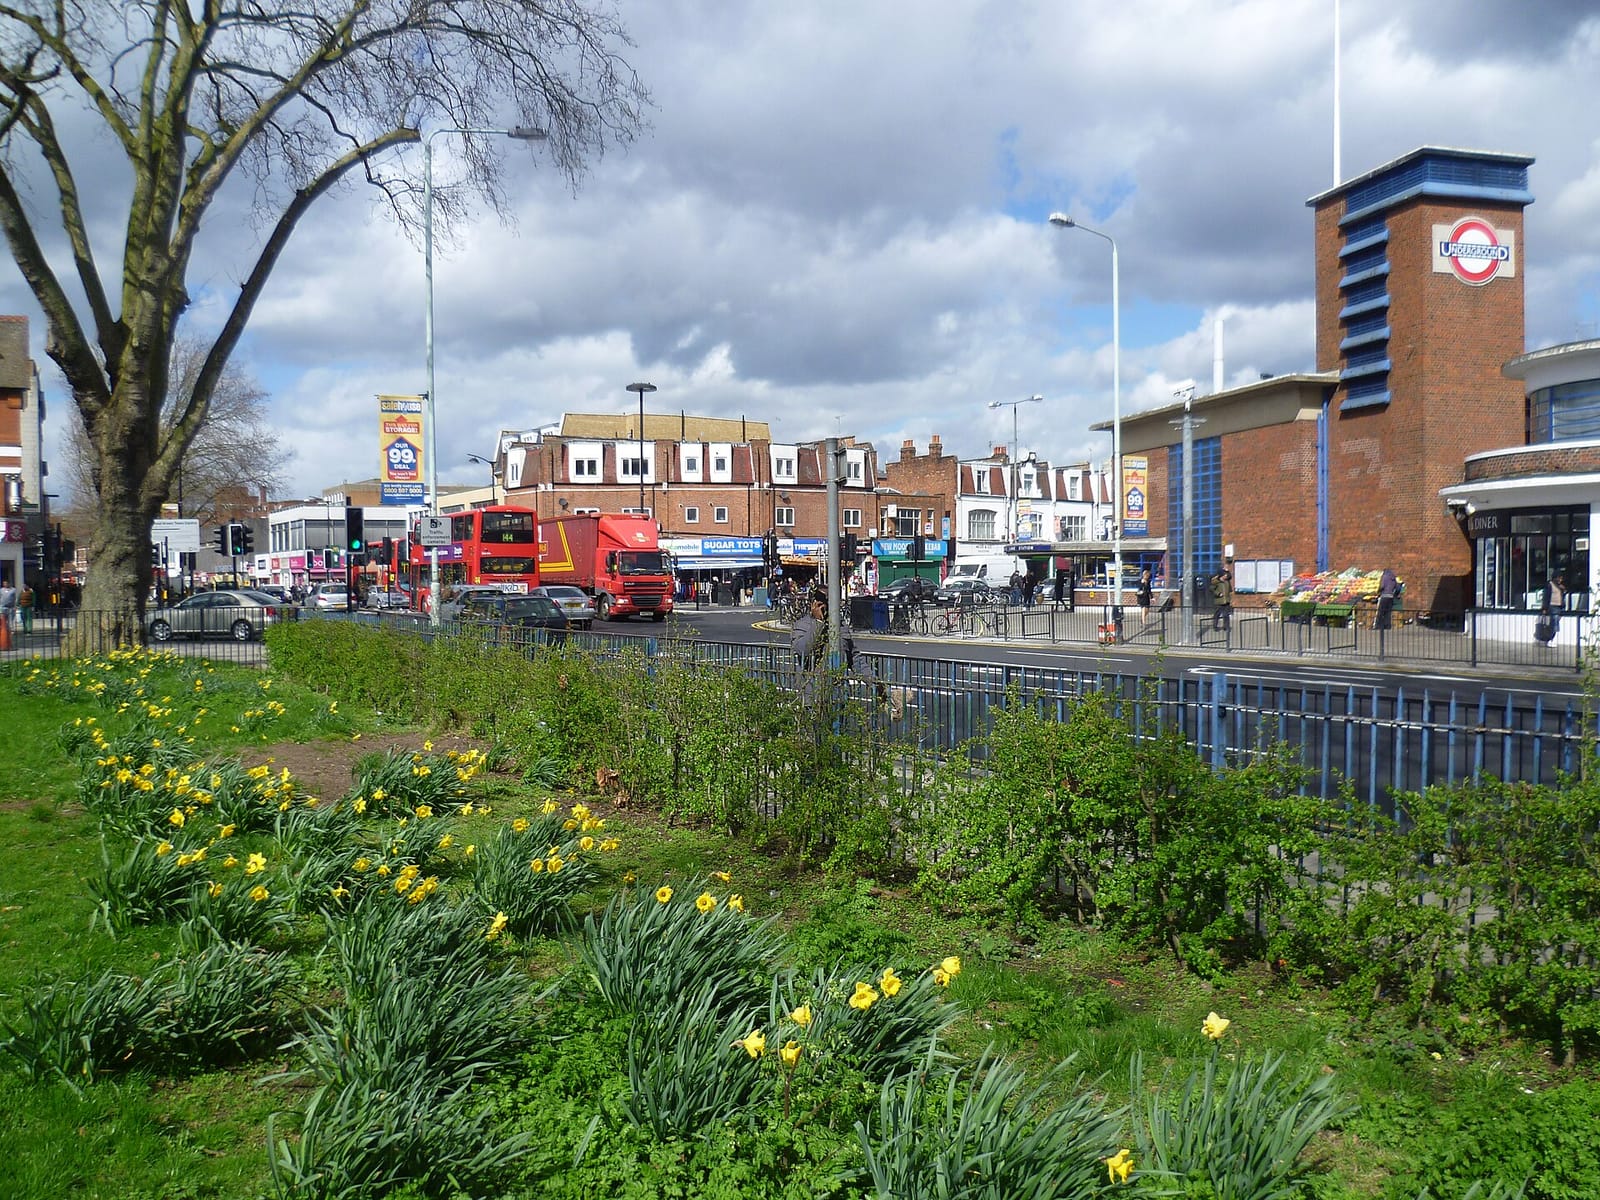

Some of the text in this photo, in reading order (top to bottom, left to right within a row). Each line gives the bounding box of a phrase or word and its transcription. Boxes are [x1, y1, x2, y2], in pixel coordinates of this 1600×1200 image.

[1441, 243, 1508, 260] UNDERGROUND
[1475, 515, 1498, 530] DINER
[704, 541, 760, 549] SUGAR TOTS
